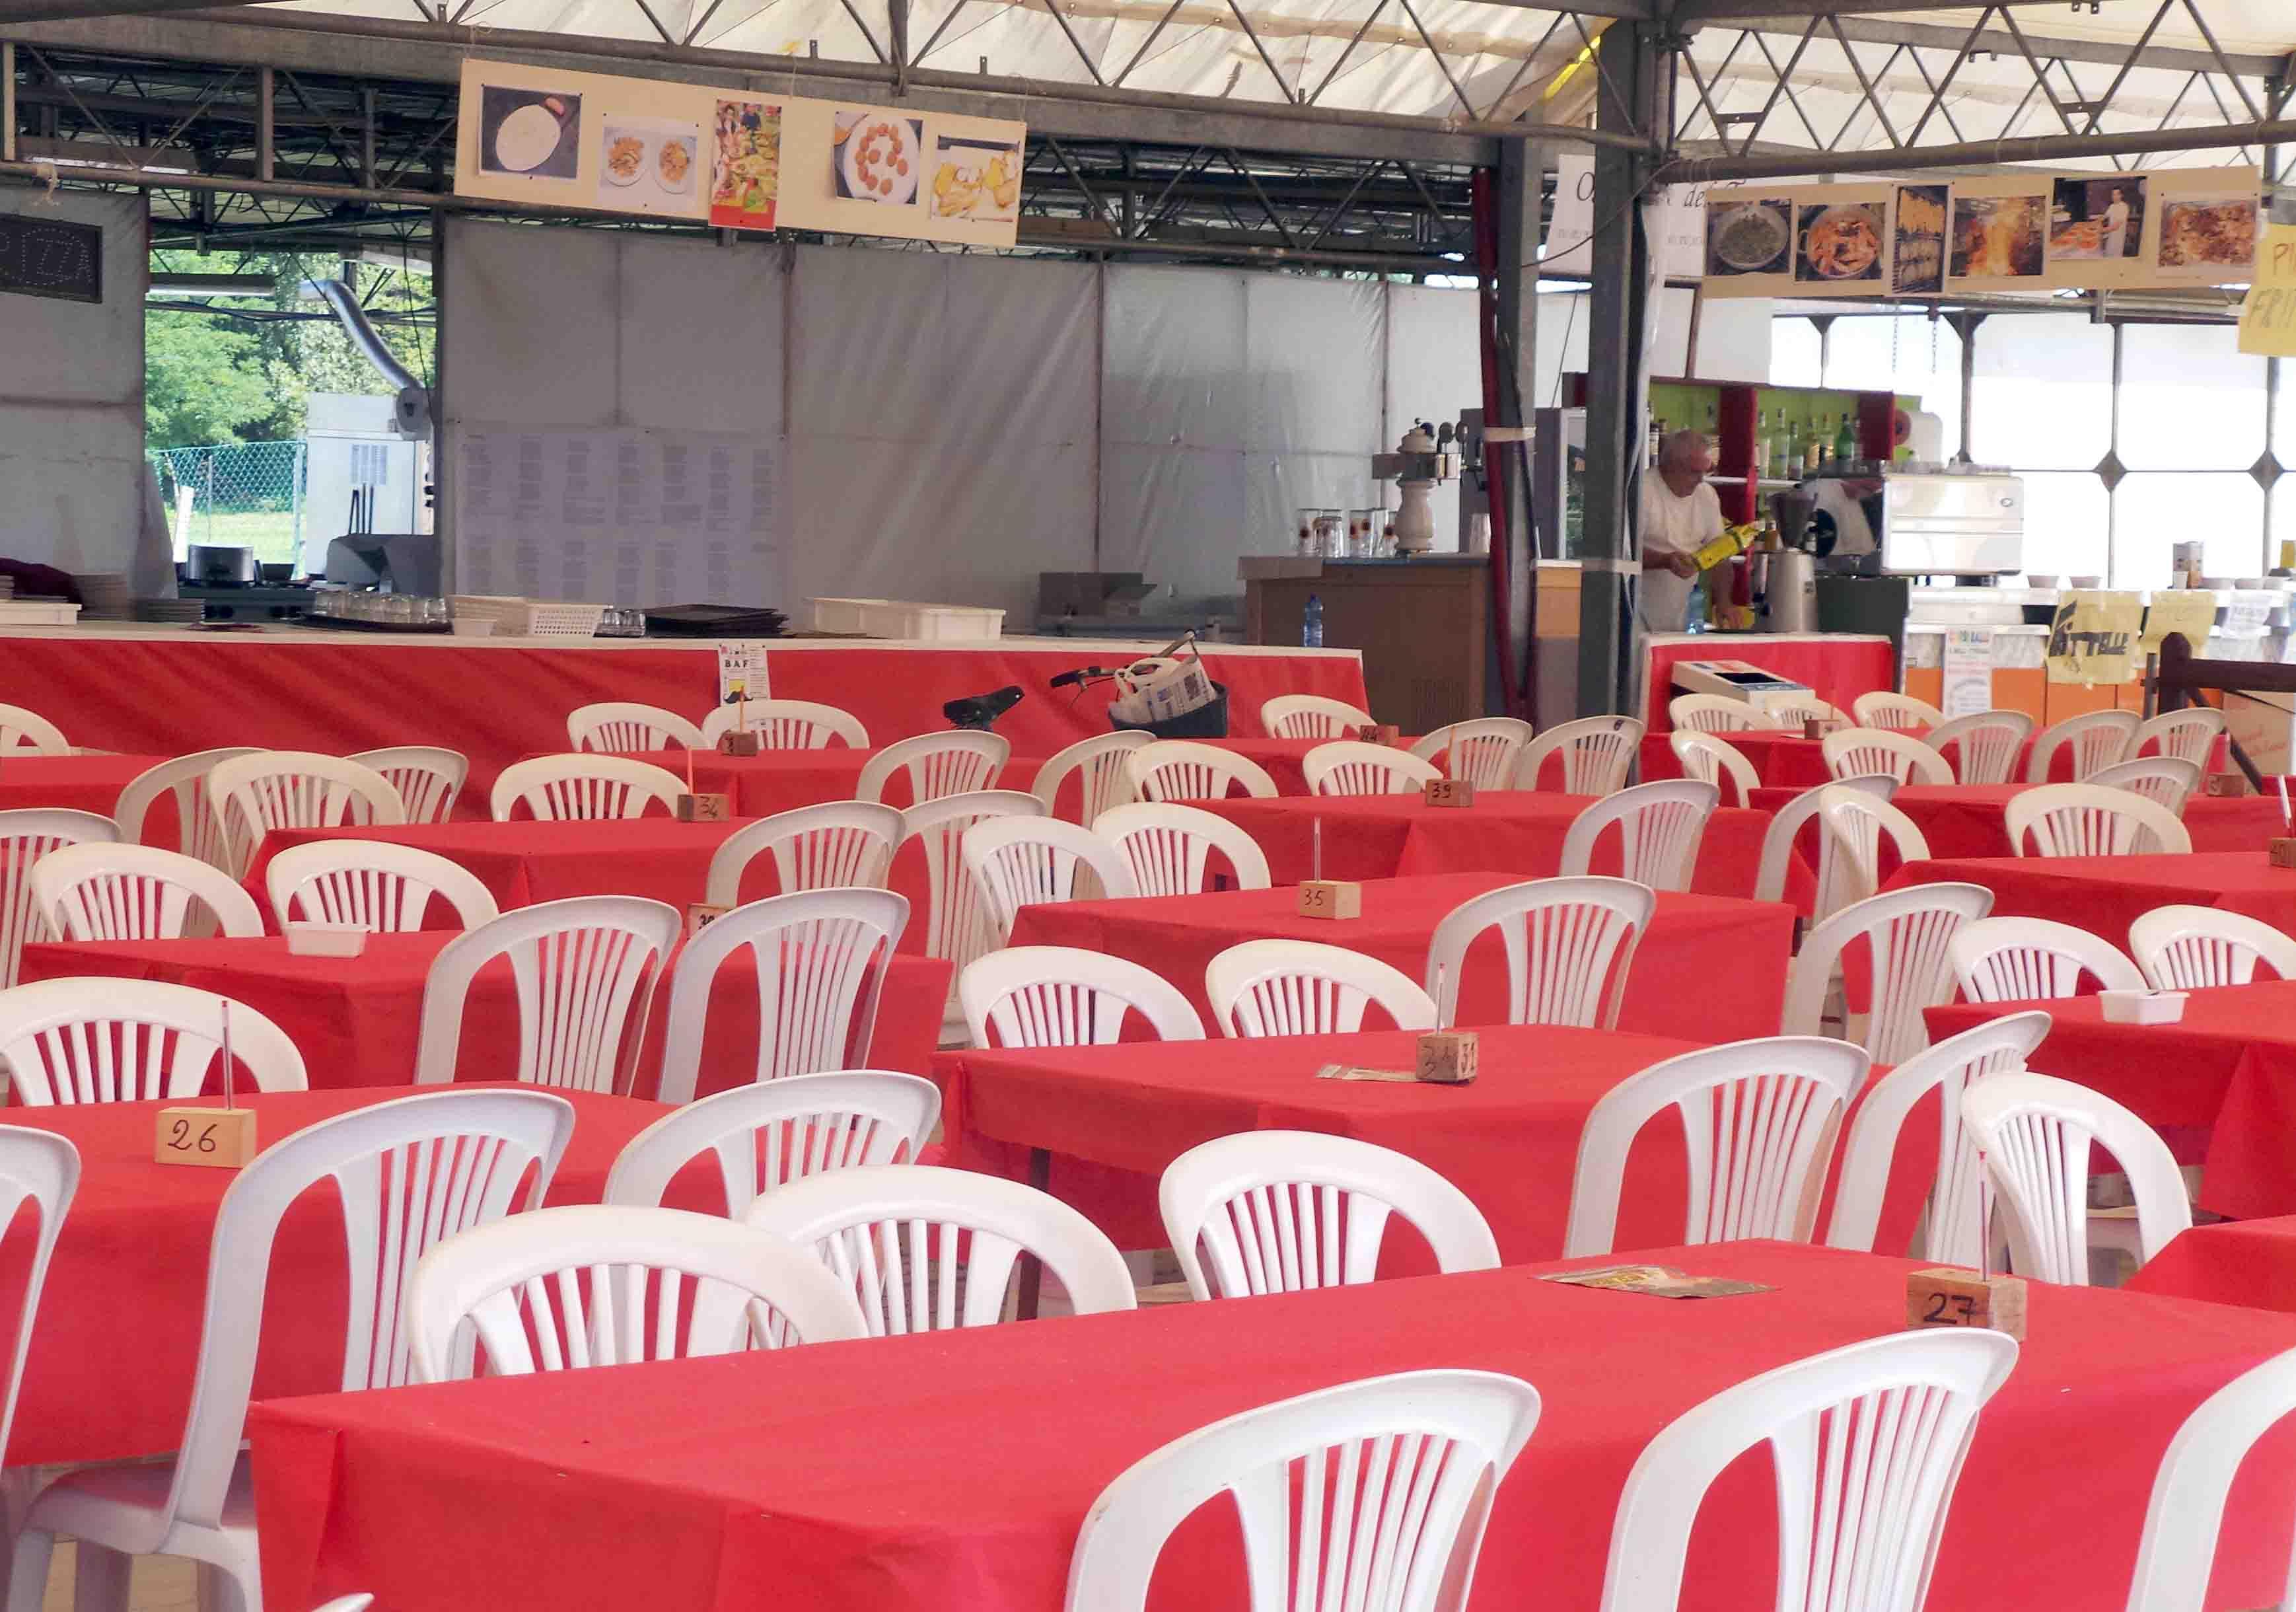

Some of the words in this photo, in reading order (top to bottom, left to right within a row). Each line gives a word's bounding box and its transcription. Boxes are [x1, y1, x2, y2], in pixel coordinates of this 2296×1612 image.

[1432, 782, 1451, 798] 39
[700, 795, 718, 819] 34
[1305, 888, 1326, 906] 35
[1461, 1042, 1475, 1073] 31
[167, 1119, 217, 1152] 26
[1923, 1292, 1976, 1325] 27
